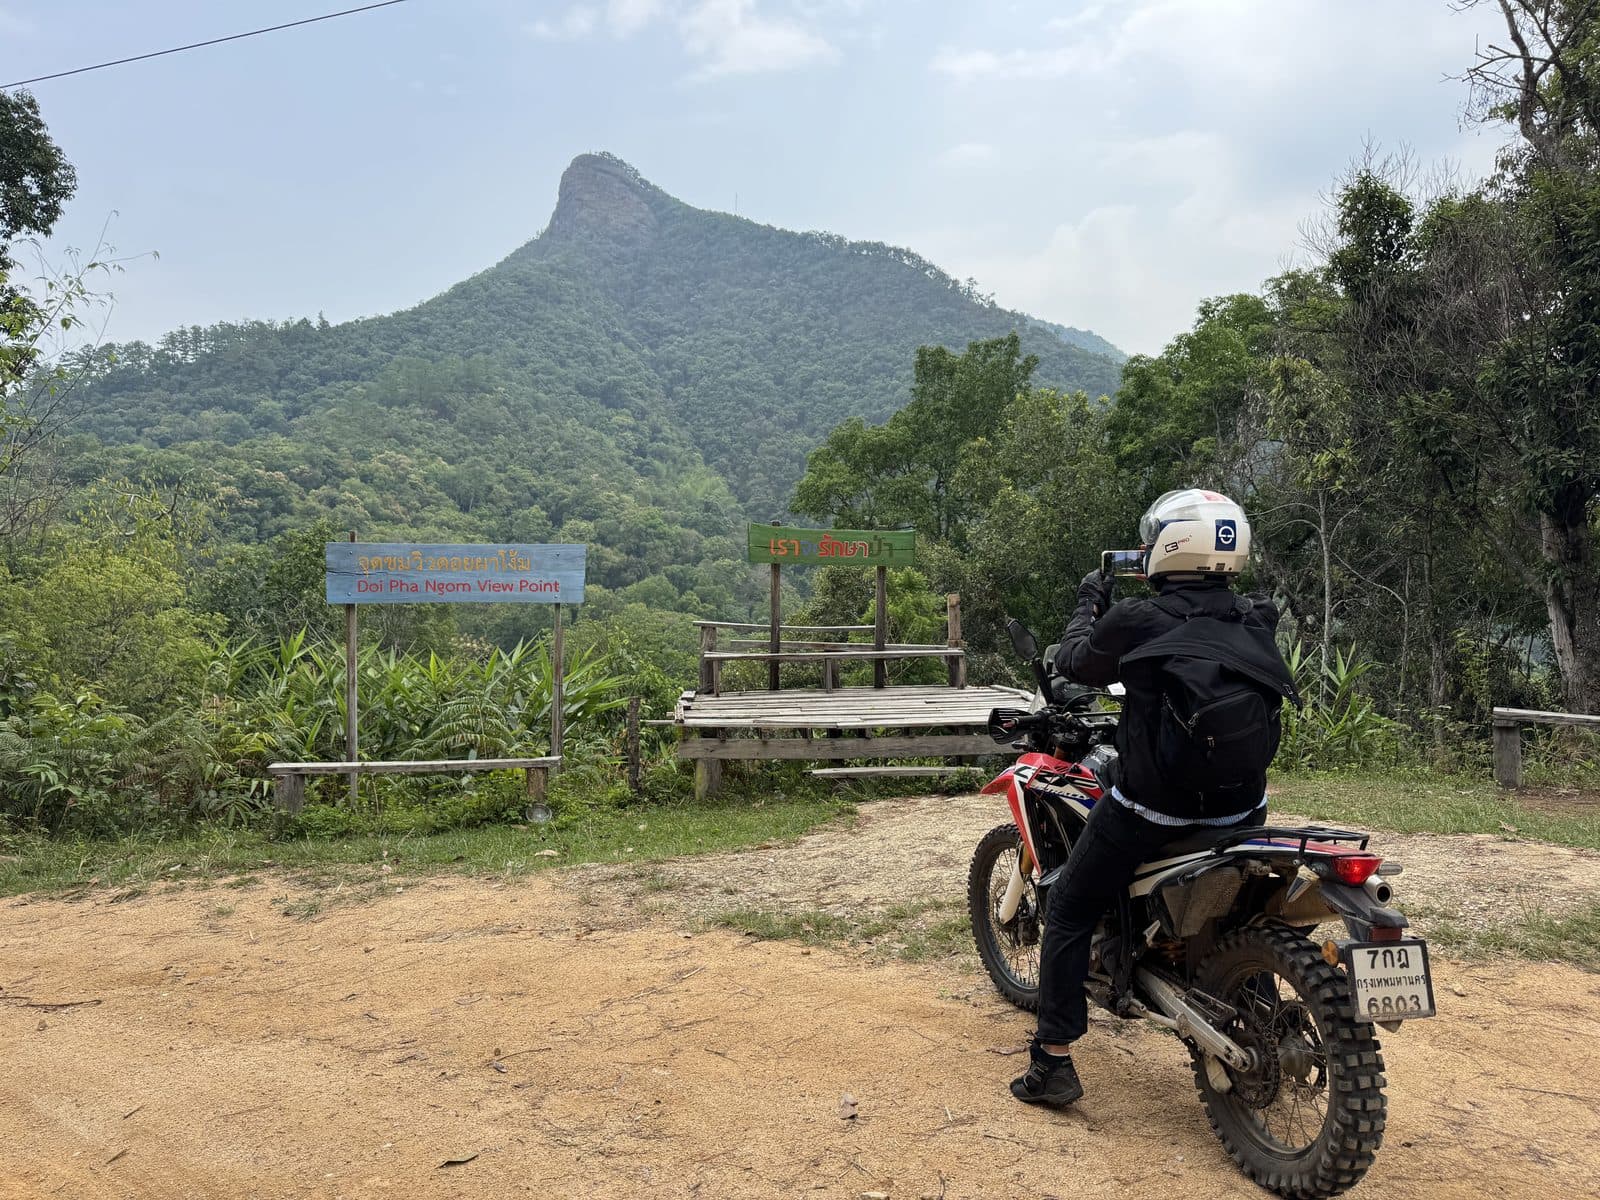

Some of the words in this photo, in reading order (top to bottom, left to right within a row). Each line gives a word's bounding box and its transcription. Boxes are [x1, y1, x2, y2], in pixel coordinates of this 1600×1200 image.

[357, 579, 384, 593] Doi
[389, 579, 419, 593] Pha
[425, 579, 472, 596] Ngom
[477, 579, 514, 593] View
[519, 579, 560, 593] Point
[1356, 974, 1427, 992] กรุงเทพมหานคร
[1367, 994, 1422, 1016] 6803
